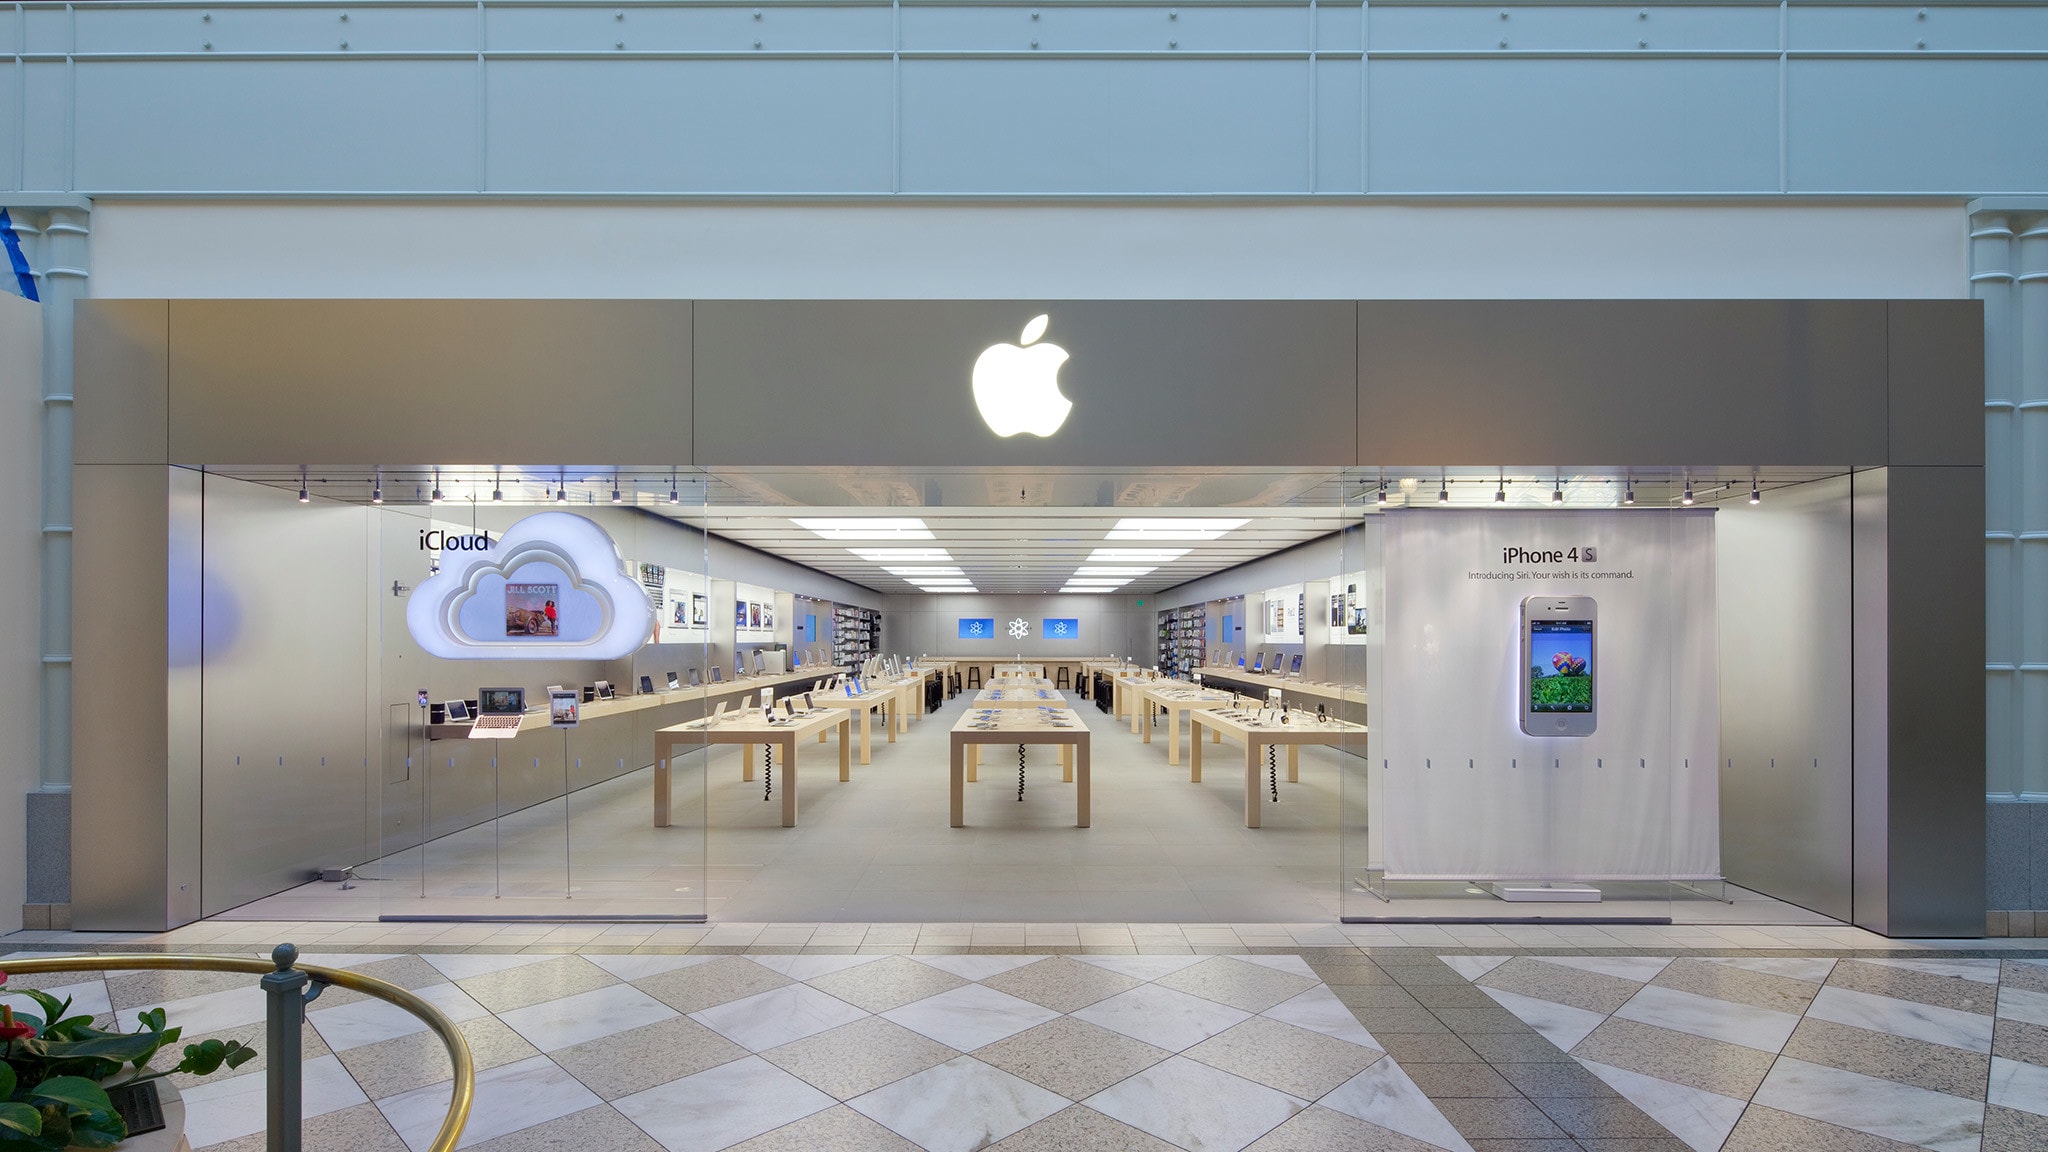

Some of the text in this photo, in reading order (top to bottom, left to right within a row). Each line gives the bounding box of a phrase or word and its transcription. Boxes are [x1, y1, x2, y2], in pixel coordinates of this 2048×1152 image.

[419, 529, 488, 551] iCloud
[1503, 547, 1563, 564] iPhone
[1567, 547, 1579, 563] 4
[1468, 570, 1634, 581] Introducing Siri. Your wish is its command.
[507, 585, 557, 594] JILL SCOTT
